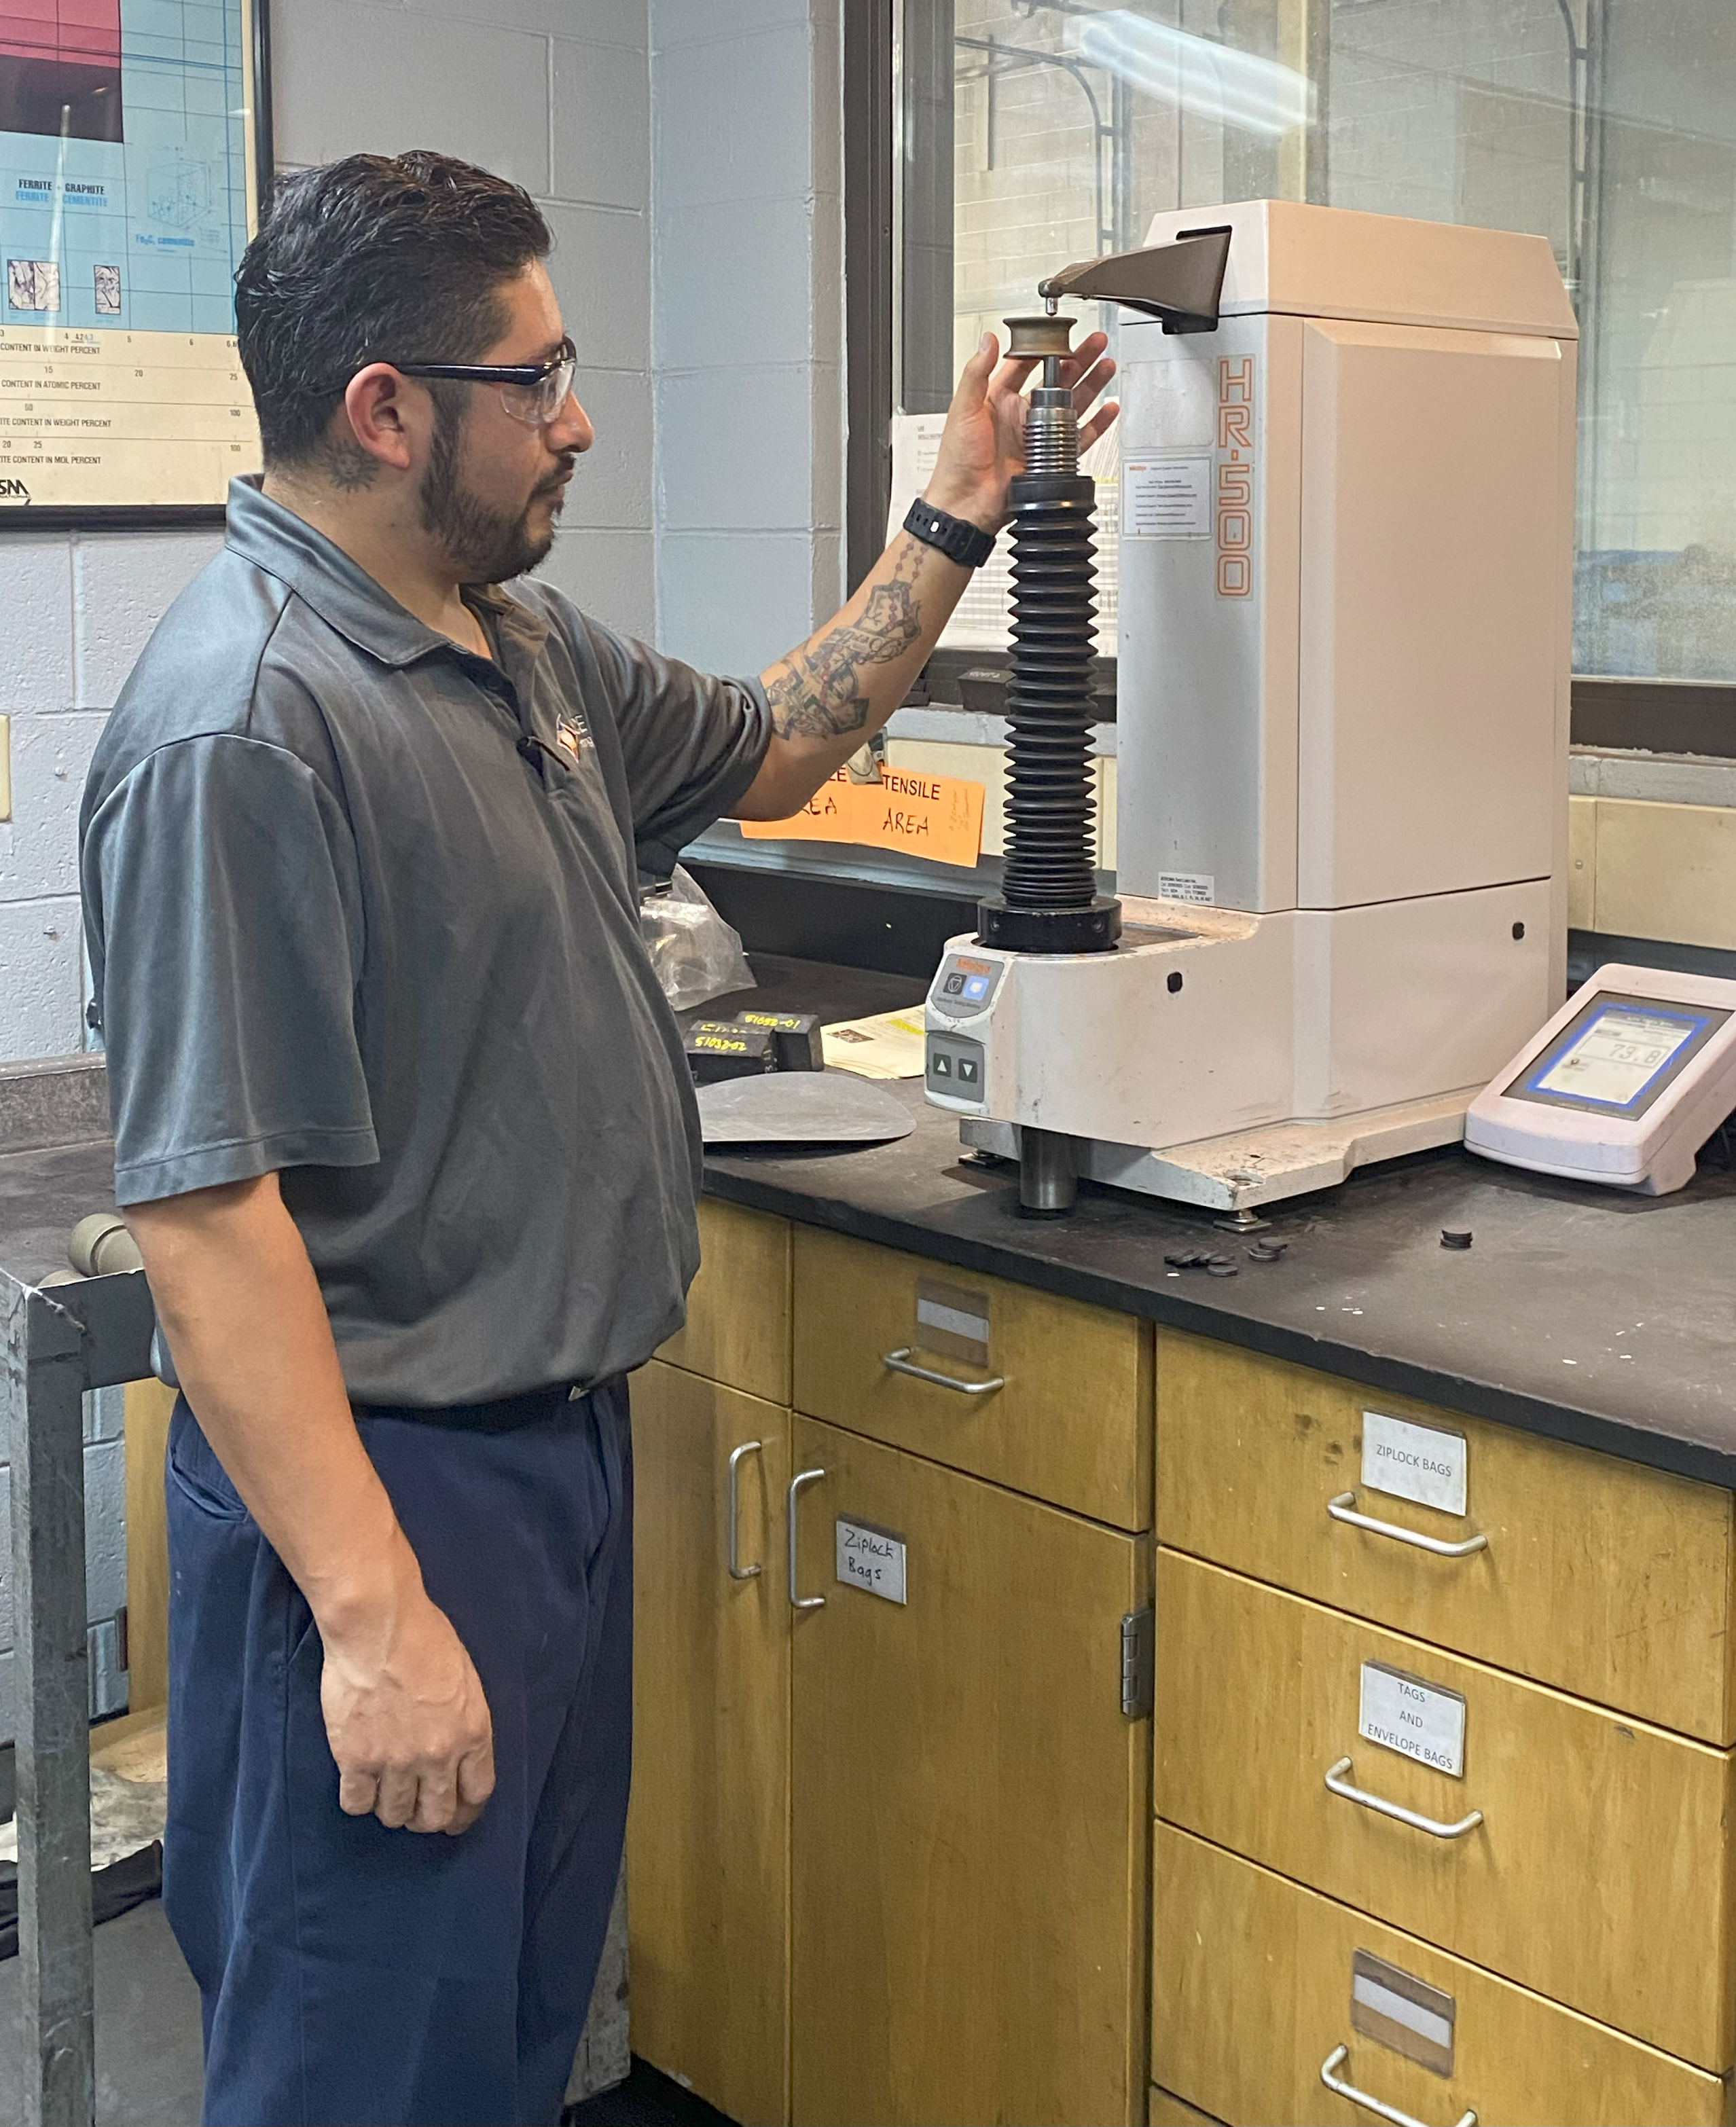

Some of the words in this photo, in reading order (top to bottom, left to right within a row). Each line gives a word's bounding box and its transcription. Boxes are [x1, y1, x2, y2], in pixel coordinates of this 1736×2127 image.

[18, 179, 52, 191] FERRITE
[65, 183, 105, 195] GRAPHITE
[16, 190, 50, 202] FERRITE
[62, 194, 107, 206] CEMENTITE
[0, 343, 31, 352] CONTENT
[42, 344, 69, 353] WEIGHT
[71, 346, 100, 354] PERCENT
[44, 365, 53, 374] 15
[1, 380, 33, 388] CONTENT
[35, 380, 42, 388] IN
[43, 381, 69, 389] ATOMIC
[71, 382, 101, 390] PERCENT
[3, 440, 11, 448] 20
[13, 456, 44, 464] CONTENT
[71, 456, 101, 465] PERCENT
[1218, 359, 1252, 596] HR-500
[883, 774, 941, 801] TENSILE
[802, 797, 837, 816] EA
[882, 807, 929, 837] AREA
[1377, 1444, 1419, 1468] ZIPLOCK
[1423, 1458, 1452, 1477] BAGS
[844, 1528, 893, 1559] Ziplock
[848, 1555, 882, 1586] Bags
[1397, 1681, 1426, 1703] TAGS
[1399, 1711, 1423, 1728] AND
[1368, 1724, 1421, 1756] ENVELOPE
[1424, 1748, 1453, 1770] BAGS
